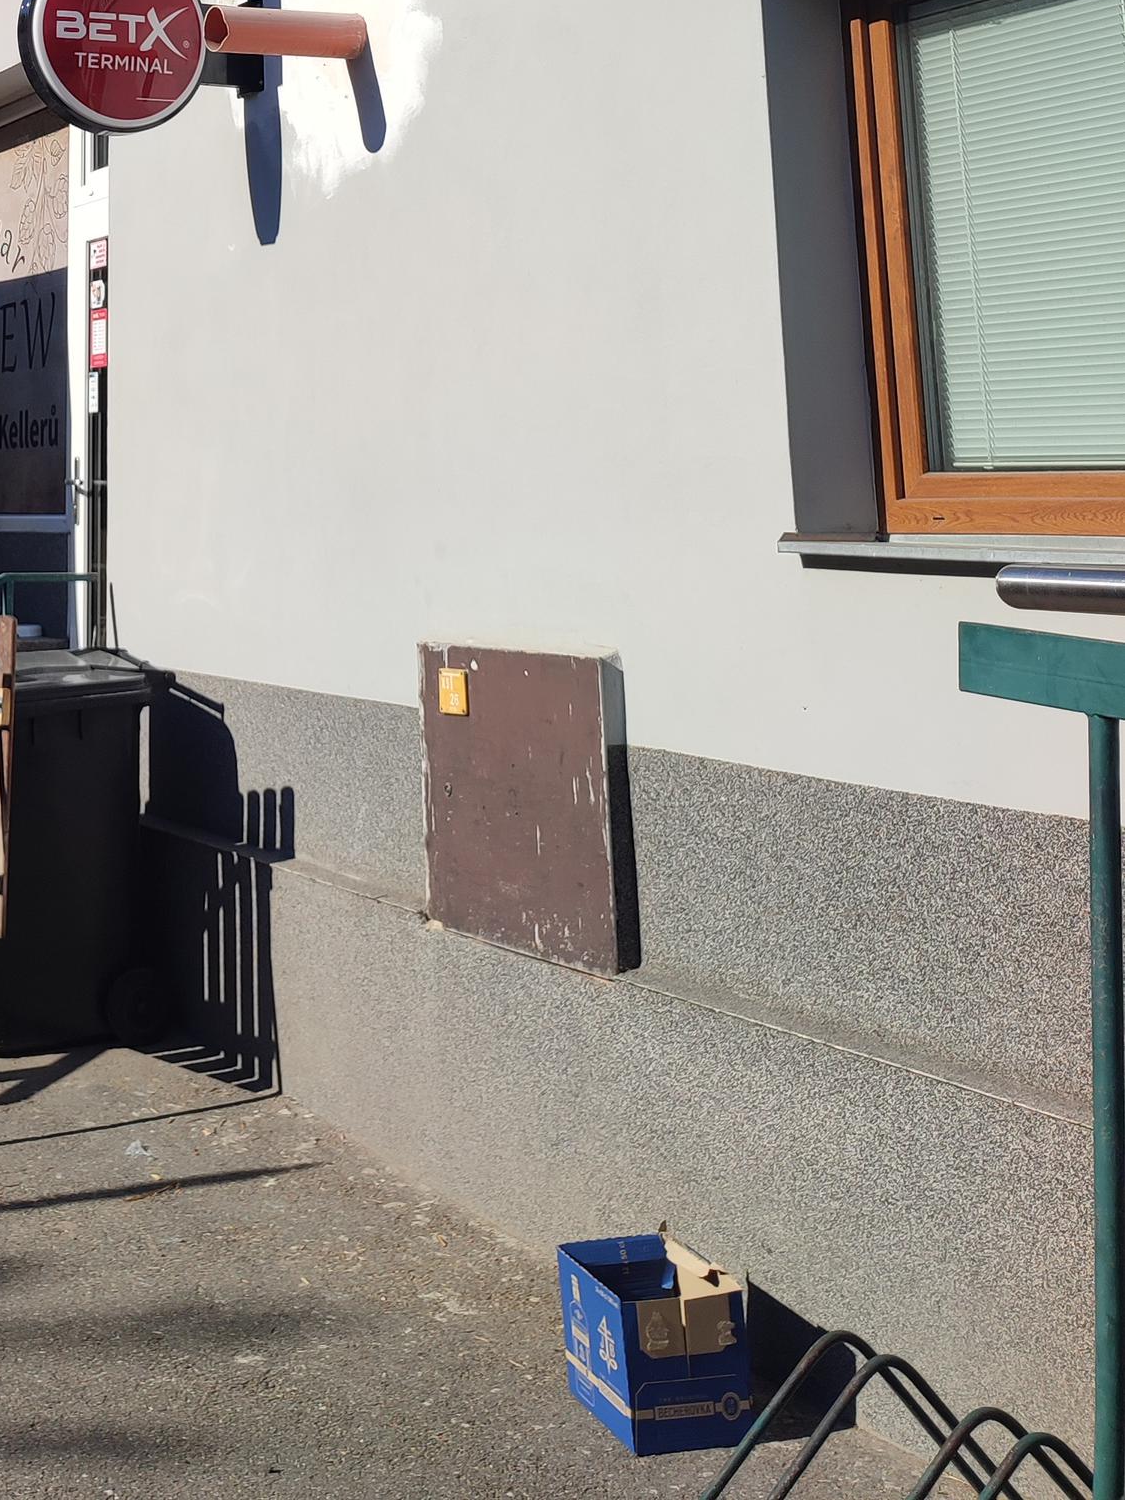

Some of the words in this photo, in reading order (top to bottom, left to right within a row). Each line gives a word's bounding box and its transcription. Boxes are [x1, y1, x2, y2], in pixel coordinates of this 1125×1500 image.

[56, 6, 190, 60] BETX
[75, 51, 173, 75] TERMINAL
[0, 404, 59, 450] Kellerů
